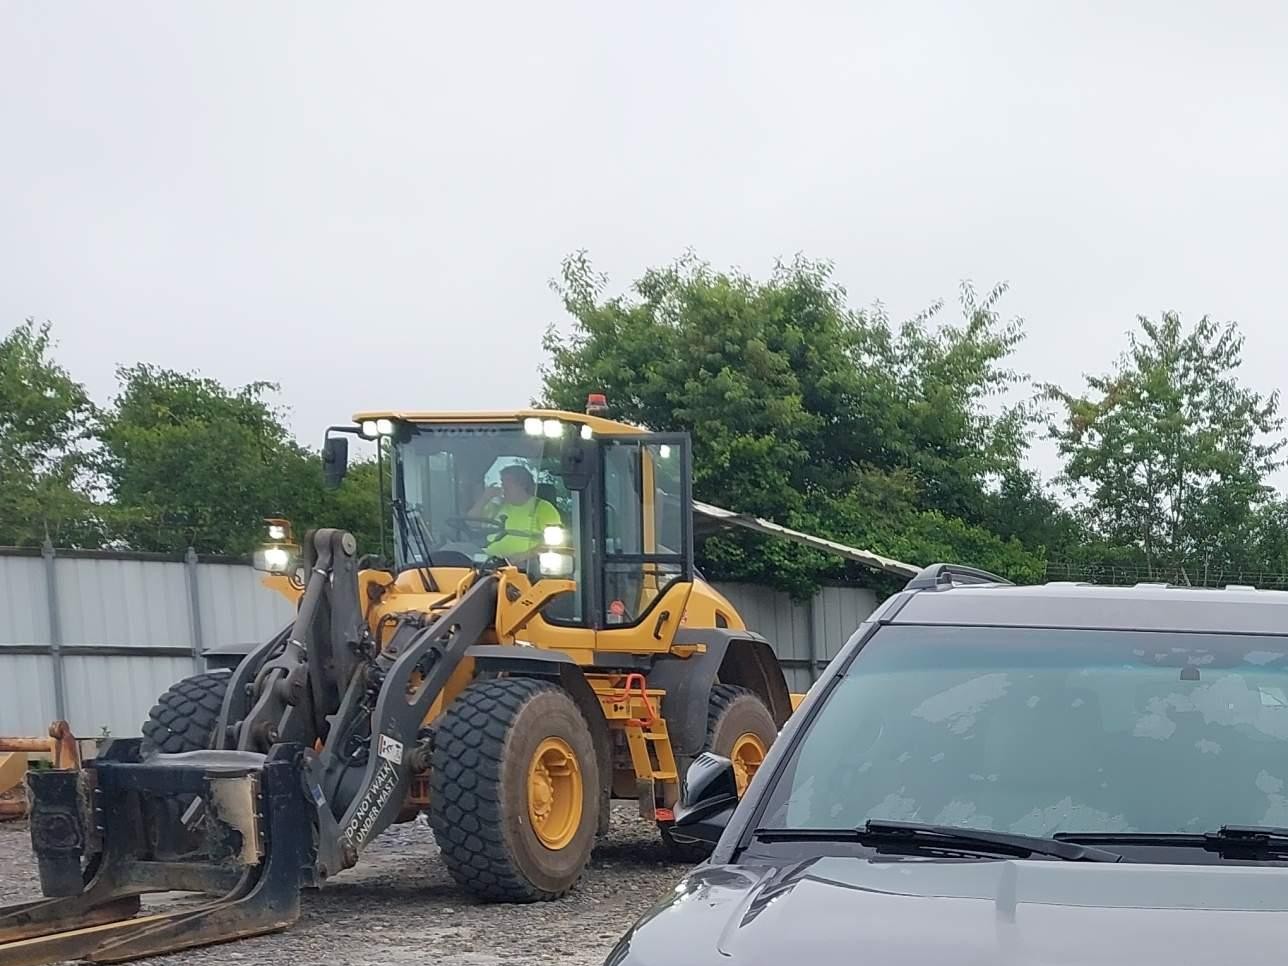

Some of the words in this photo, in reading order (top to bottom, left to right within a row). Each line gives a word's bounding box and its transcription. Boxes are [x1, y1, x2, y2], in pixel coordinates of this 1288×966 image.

[346, 819, 359, 838] DO
[356, 795, 374, 820] NOT
[370, 762, 391, 796] WALK
[356, 807, 379, 842] UNDER
[376, 777, 395, 808] MAST
